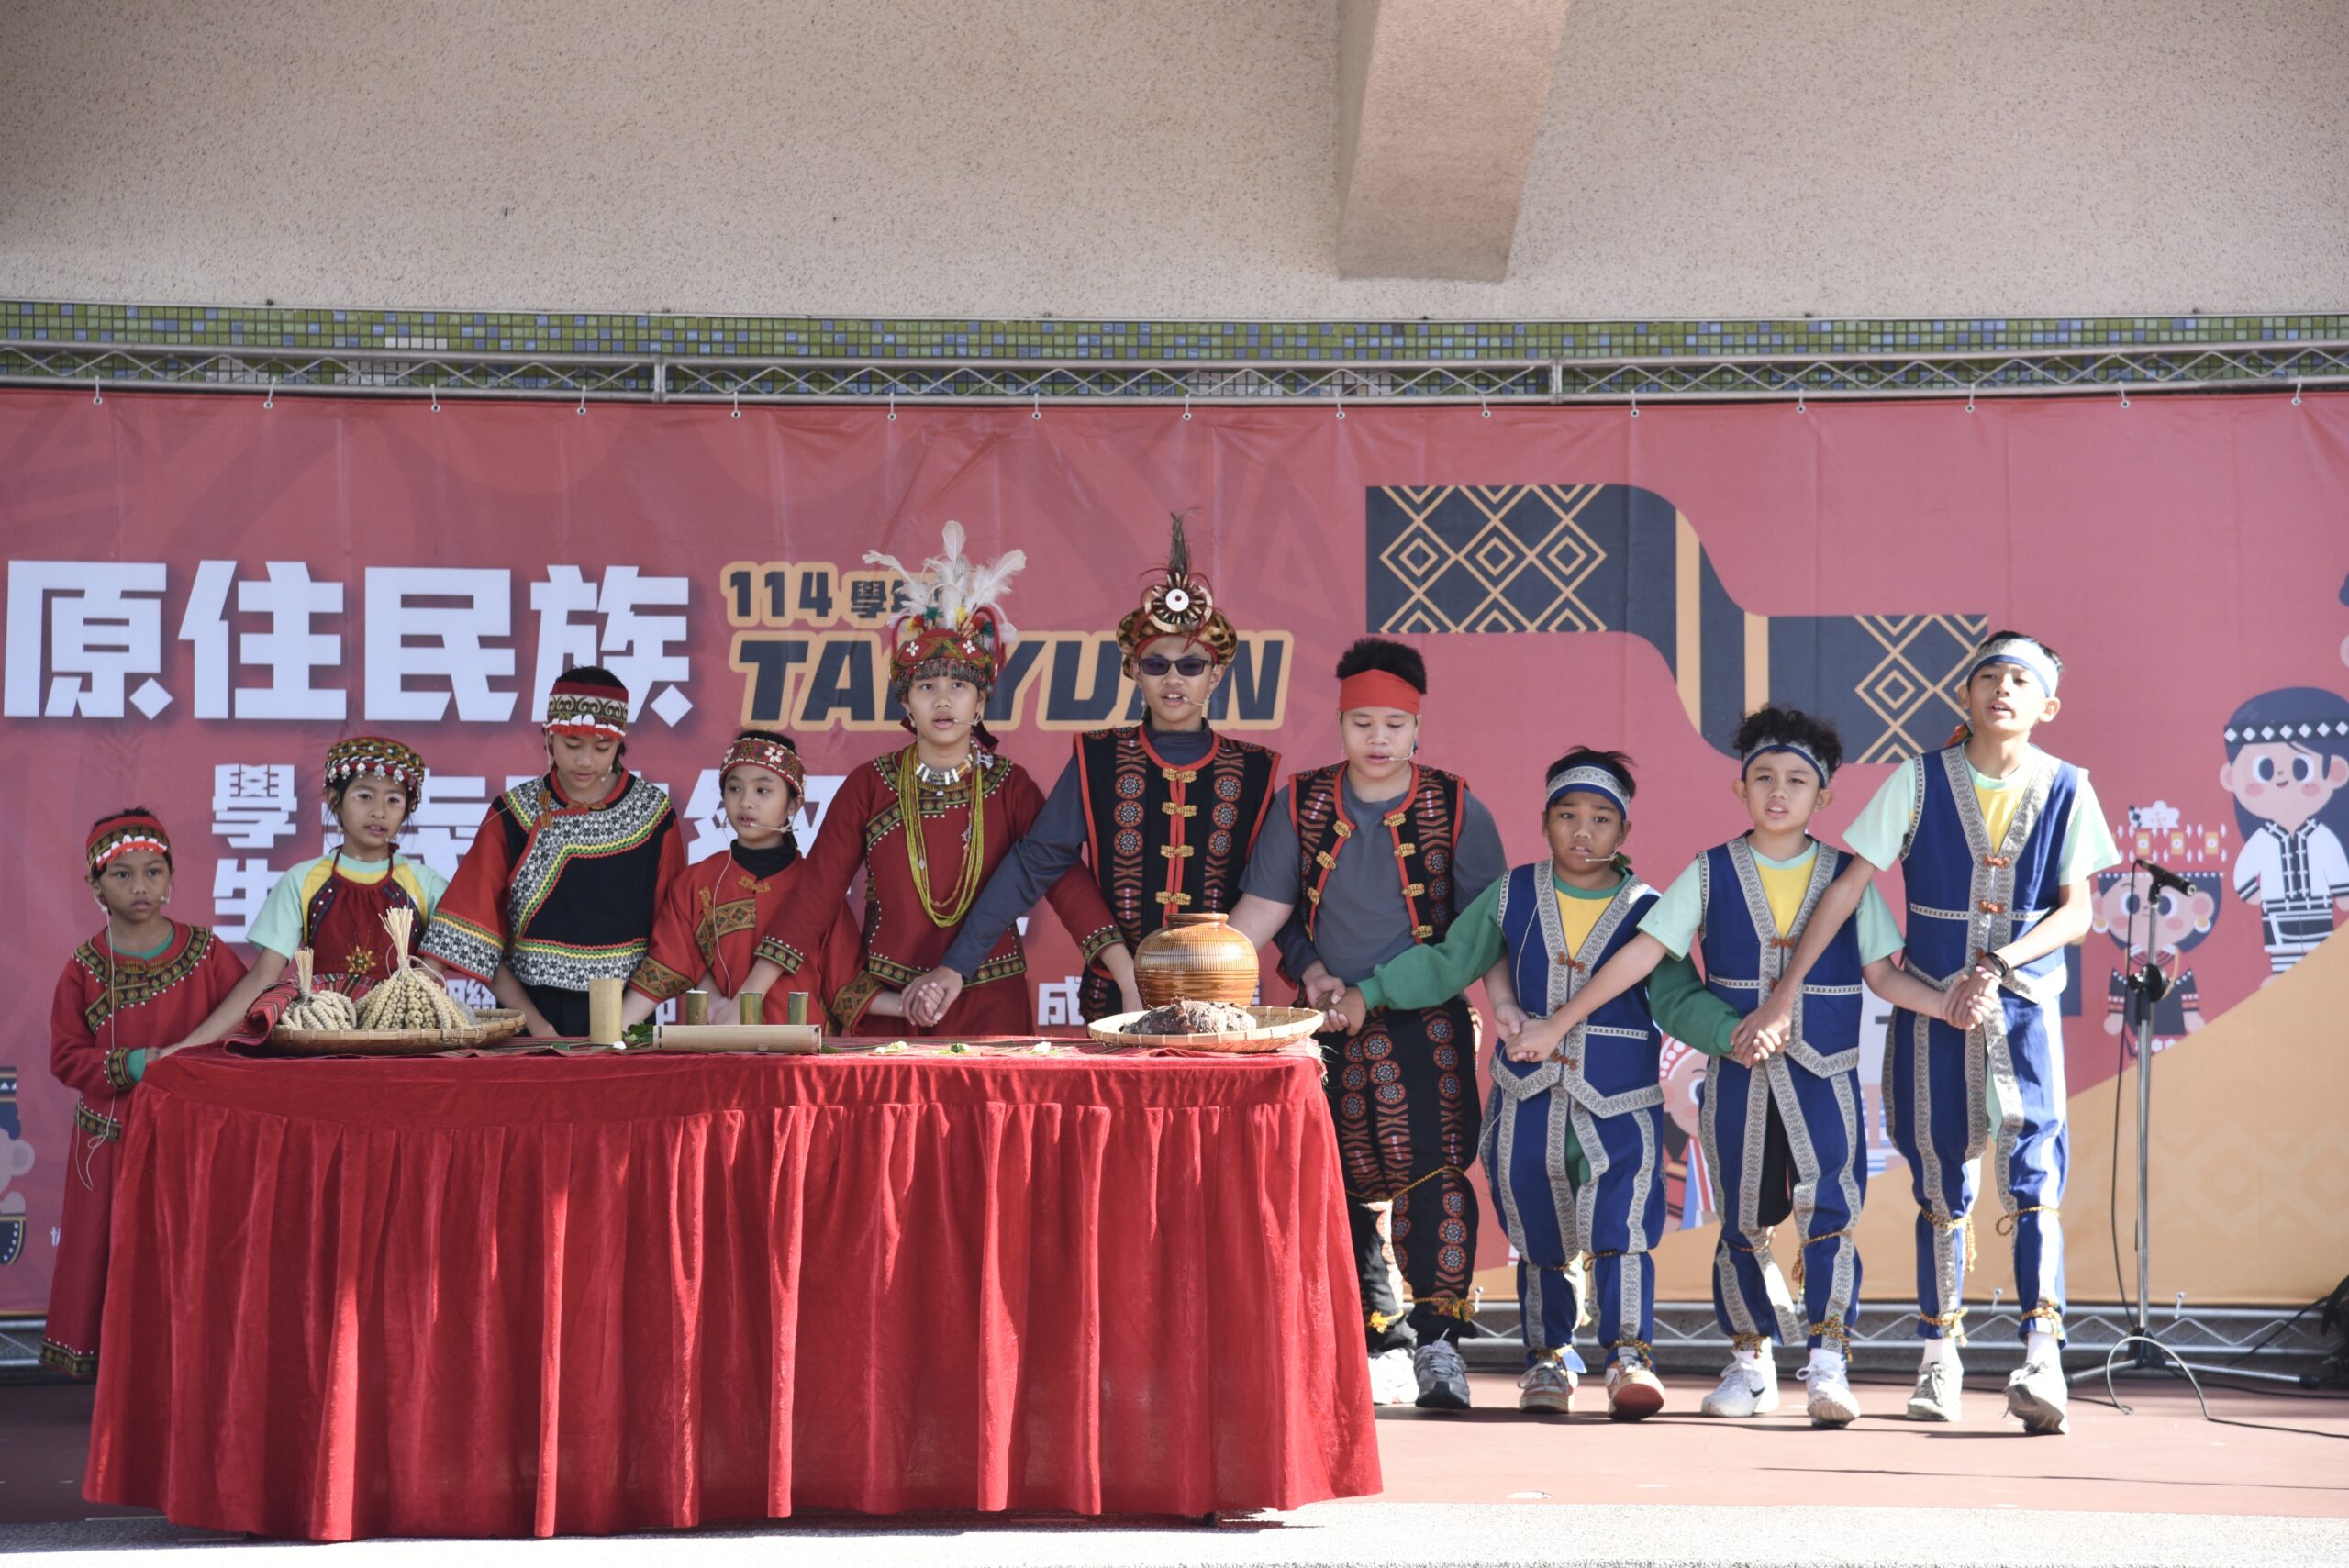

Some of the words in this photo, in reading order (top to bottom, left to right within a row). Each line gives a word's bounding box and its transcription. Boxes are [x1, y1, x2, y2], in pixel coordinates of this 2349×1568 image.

[4, 560, 694, 728] 原住民族
[739, 639, 1285, 722] TAYUN
